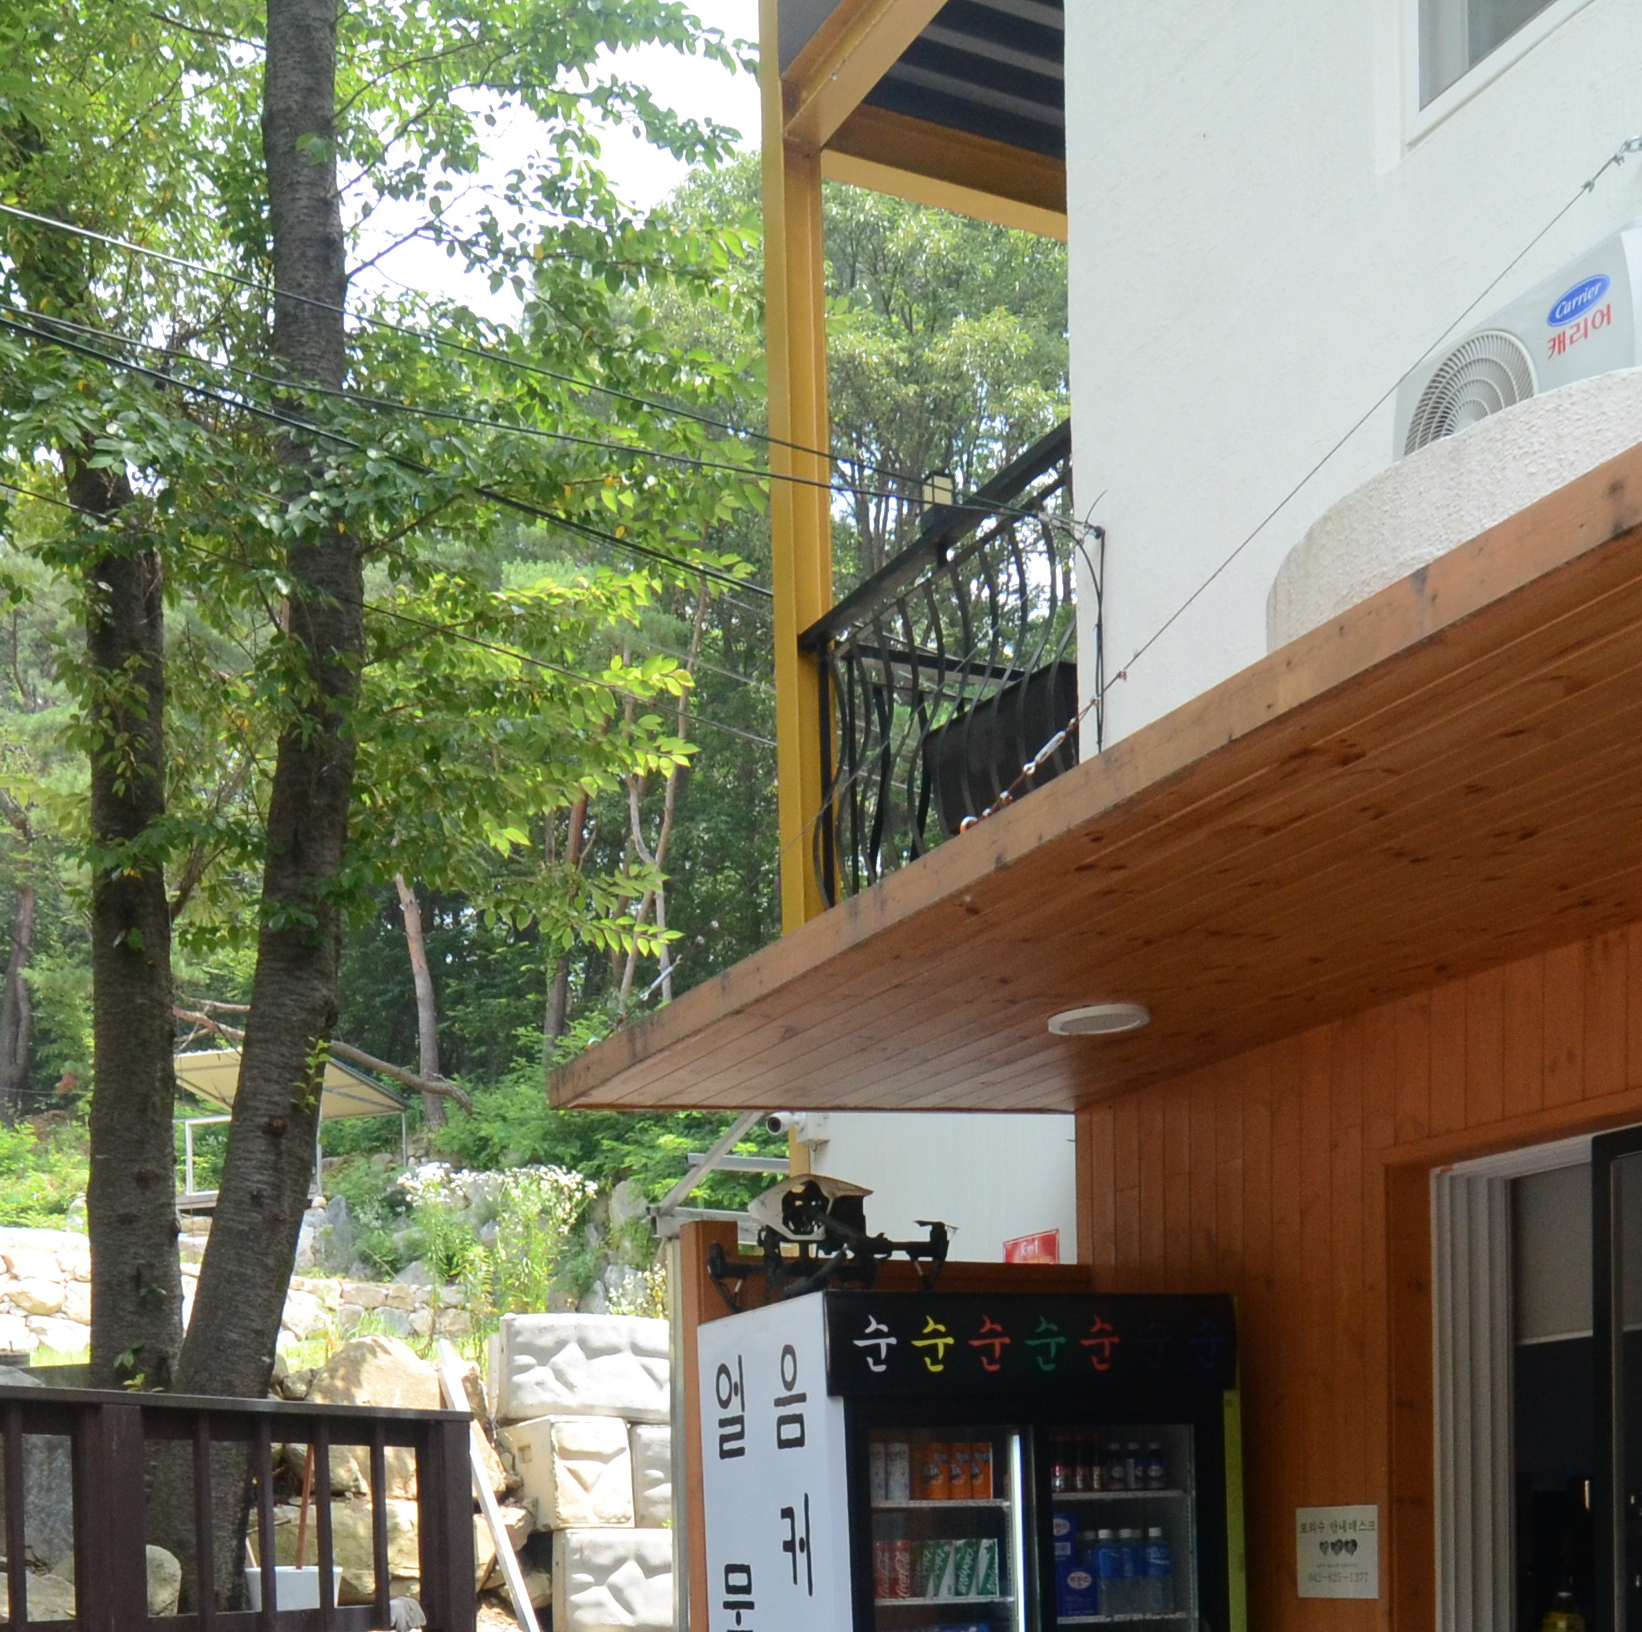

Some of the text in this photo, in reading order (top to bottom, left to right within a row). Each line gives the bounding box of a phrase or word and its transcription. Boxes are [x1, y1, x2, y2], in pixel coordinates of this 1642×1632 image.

[1555, 282, 1602, 319] Carrier
[1547, 303, 1612, 360] 캐리어
[853, 1315, 897, 1373] 순
[911, 1315, 954, 1373] 순
[968, 1315, 1011, 1372] 순
[1024, 1315, 1066, 1372] 순
[1079, 1315, 1120, 1372] 순
